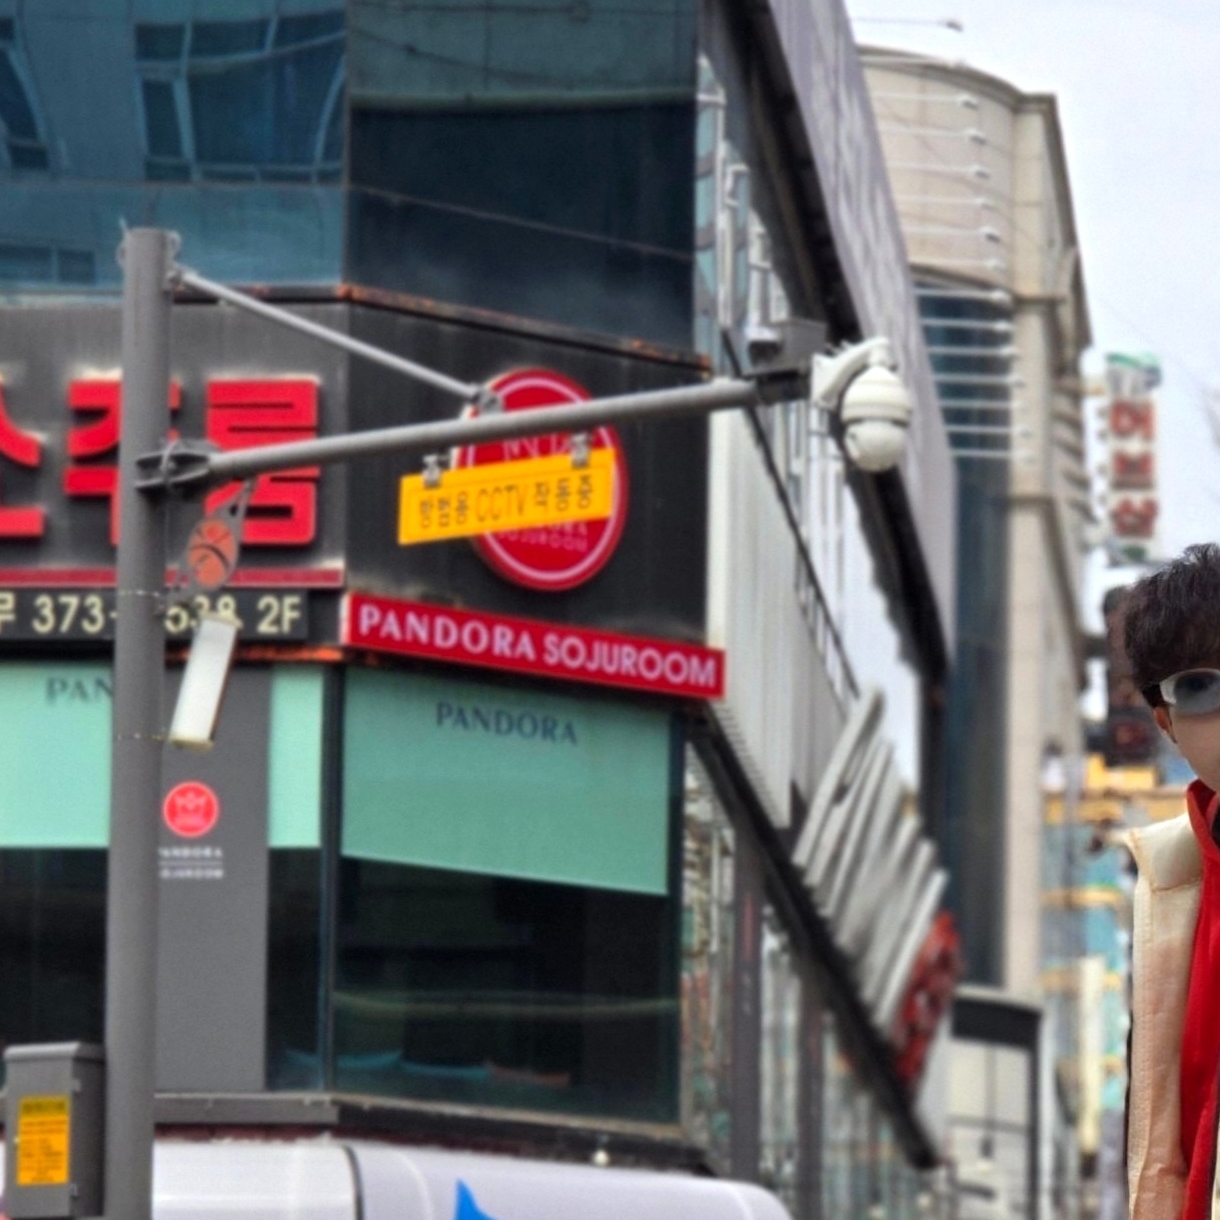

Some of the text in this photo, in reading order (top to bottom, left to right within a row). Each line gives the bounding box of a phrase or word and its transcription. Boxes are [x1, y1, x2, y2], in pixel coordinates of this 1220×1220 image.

[475, 482, 529, 522] CCTV
[256, 593, 302, 635] 2F
[359, 604, 717, 688] PANDORA SOJUROOM
[435, 702, 578, 746] PANDORA
